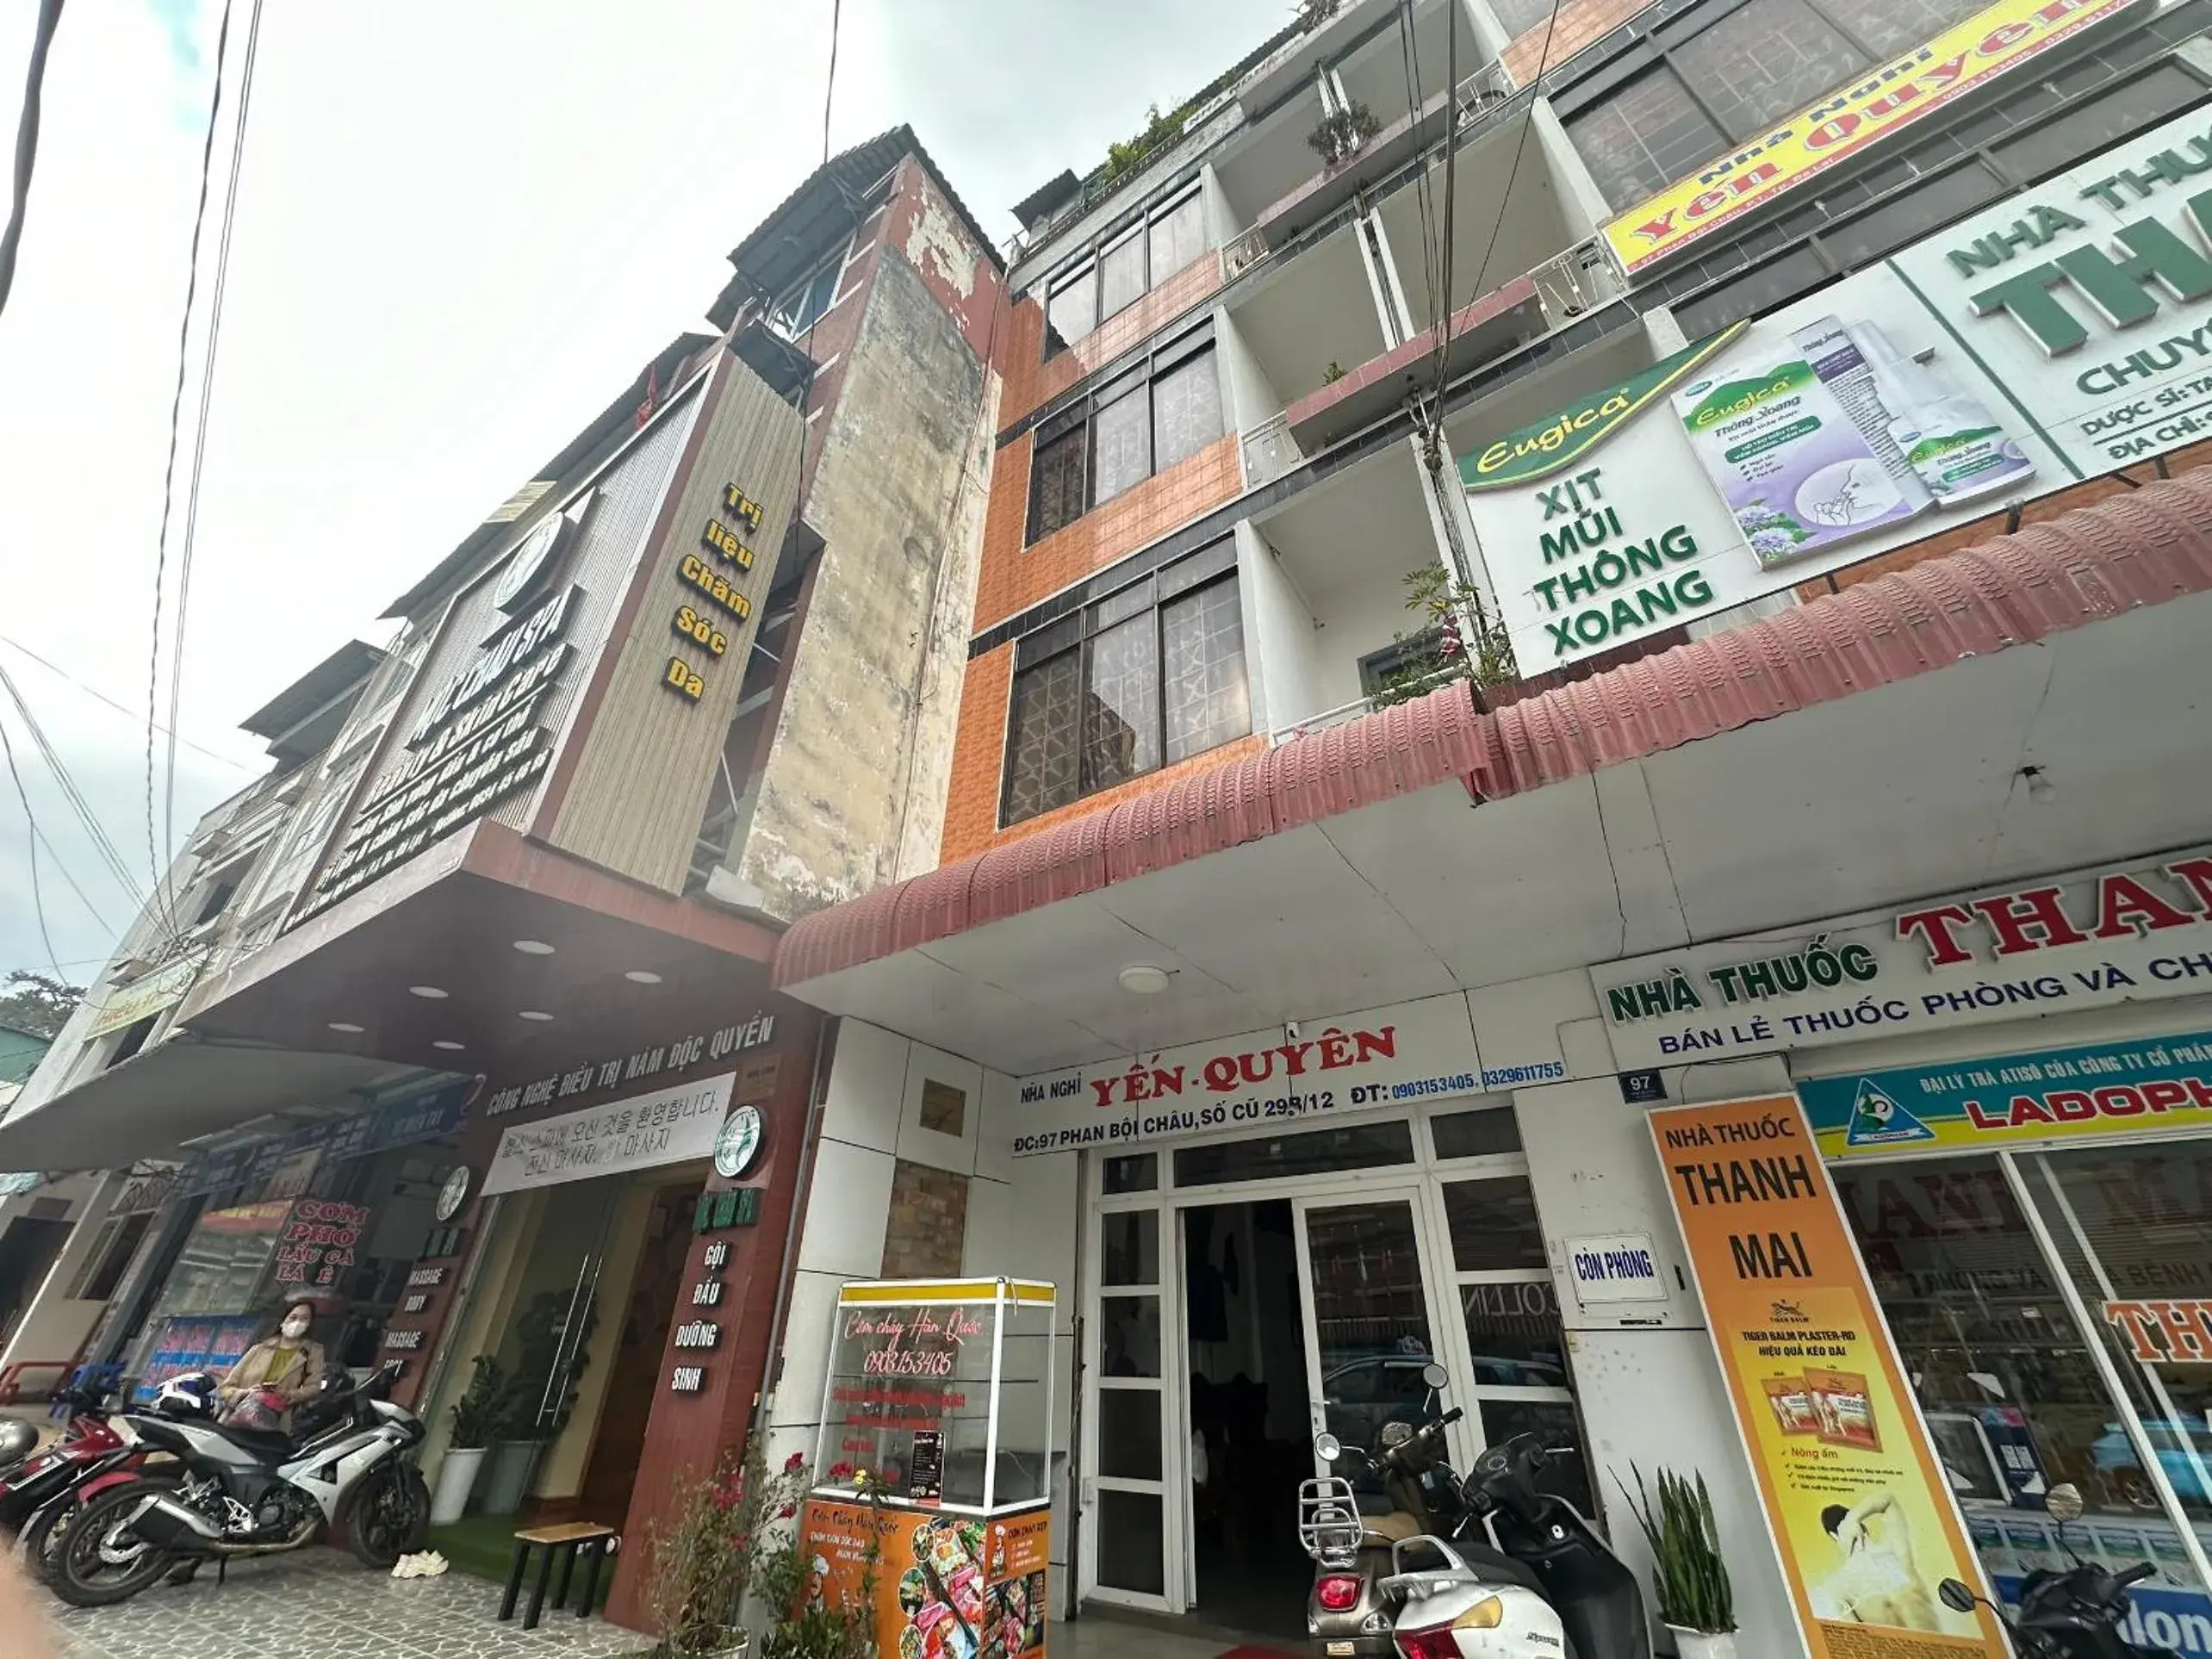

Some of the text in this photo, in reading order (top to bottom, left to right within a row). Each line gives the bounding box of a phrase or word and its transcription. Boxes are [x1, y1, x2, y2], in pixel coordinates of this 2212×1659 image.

[1946, 204, 2087, 278] NHÀ
[2076, 318, 2212, 395] CHUY
[1697, 377, 1790, 426] Eugica
[2080, 401, 2153, 436] DƯỢC
[1476, 389, 1631, 474] Eugica
[2108, 437, 2156, 459] ĐỊA
[725, 482, 763, 531] Trị
[1536, 468, 1601, 521] XỊT
[705, 519, 755, 570] liệu
[1538, 506, 1623, 565] MŨI
[680, 554, 752, 620] Chăm
[1533, 525, 1698, 611] THÔNG
[674, 606, 728, 656] Sóc
[1544, 570, 1713, 656] XOANG
[497, 643, 567, 711] Care
[666, 657, 705, 701] Da
[1605, 965, 1704, 1023] NHÀ
[1707, 931, 1879, 1004] THUỐC
[1658, 1027, 1724, 1055] BÁN
[1731, 1015, 1774, 1043] LẺ
[1782, 994, 1911, 1035] THUỐC
[1921, 978, 2069, 1016] PHÒNG
[2072, 961, 2139, 992] VÀ
[1629, 1073, 1652, 1093] 97
[2080, 1051, 2122, 1076] CÔNG
[2125, 1050, 2145, 1070] TY
[1059, 1124, 1104, 1146] PHAN
[1109, 1116, 1139, 1141] BỘI
[1232, 1097, 1260, 1119] CŨ
[1350, 1084, 1389, 1105] ĐT:
[1664, 1112, 1796, 1148] NHÀ THUỐC
[1675, 1153, 1817, 1206] THANH
[704, 1240, 727, 1271] GỘI
[1575, 1243, 1655, 1281] CÒN PHÒNG
[1728, 1231, 1813, 1280] MAI
[674, 1319, 718, 1348] DƯỠNG
[1742, 1331, 1769, 1342] TIGER
[1769, 1331, 1798, 1342] BALM
[671, 1366, 702, 1392] SINH
